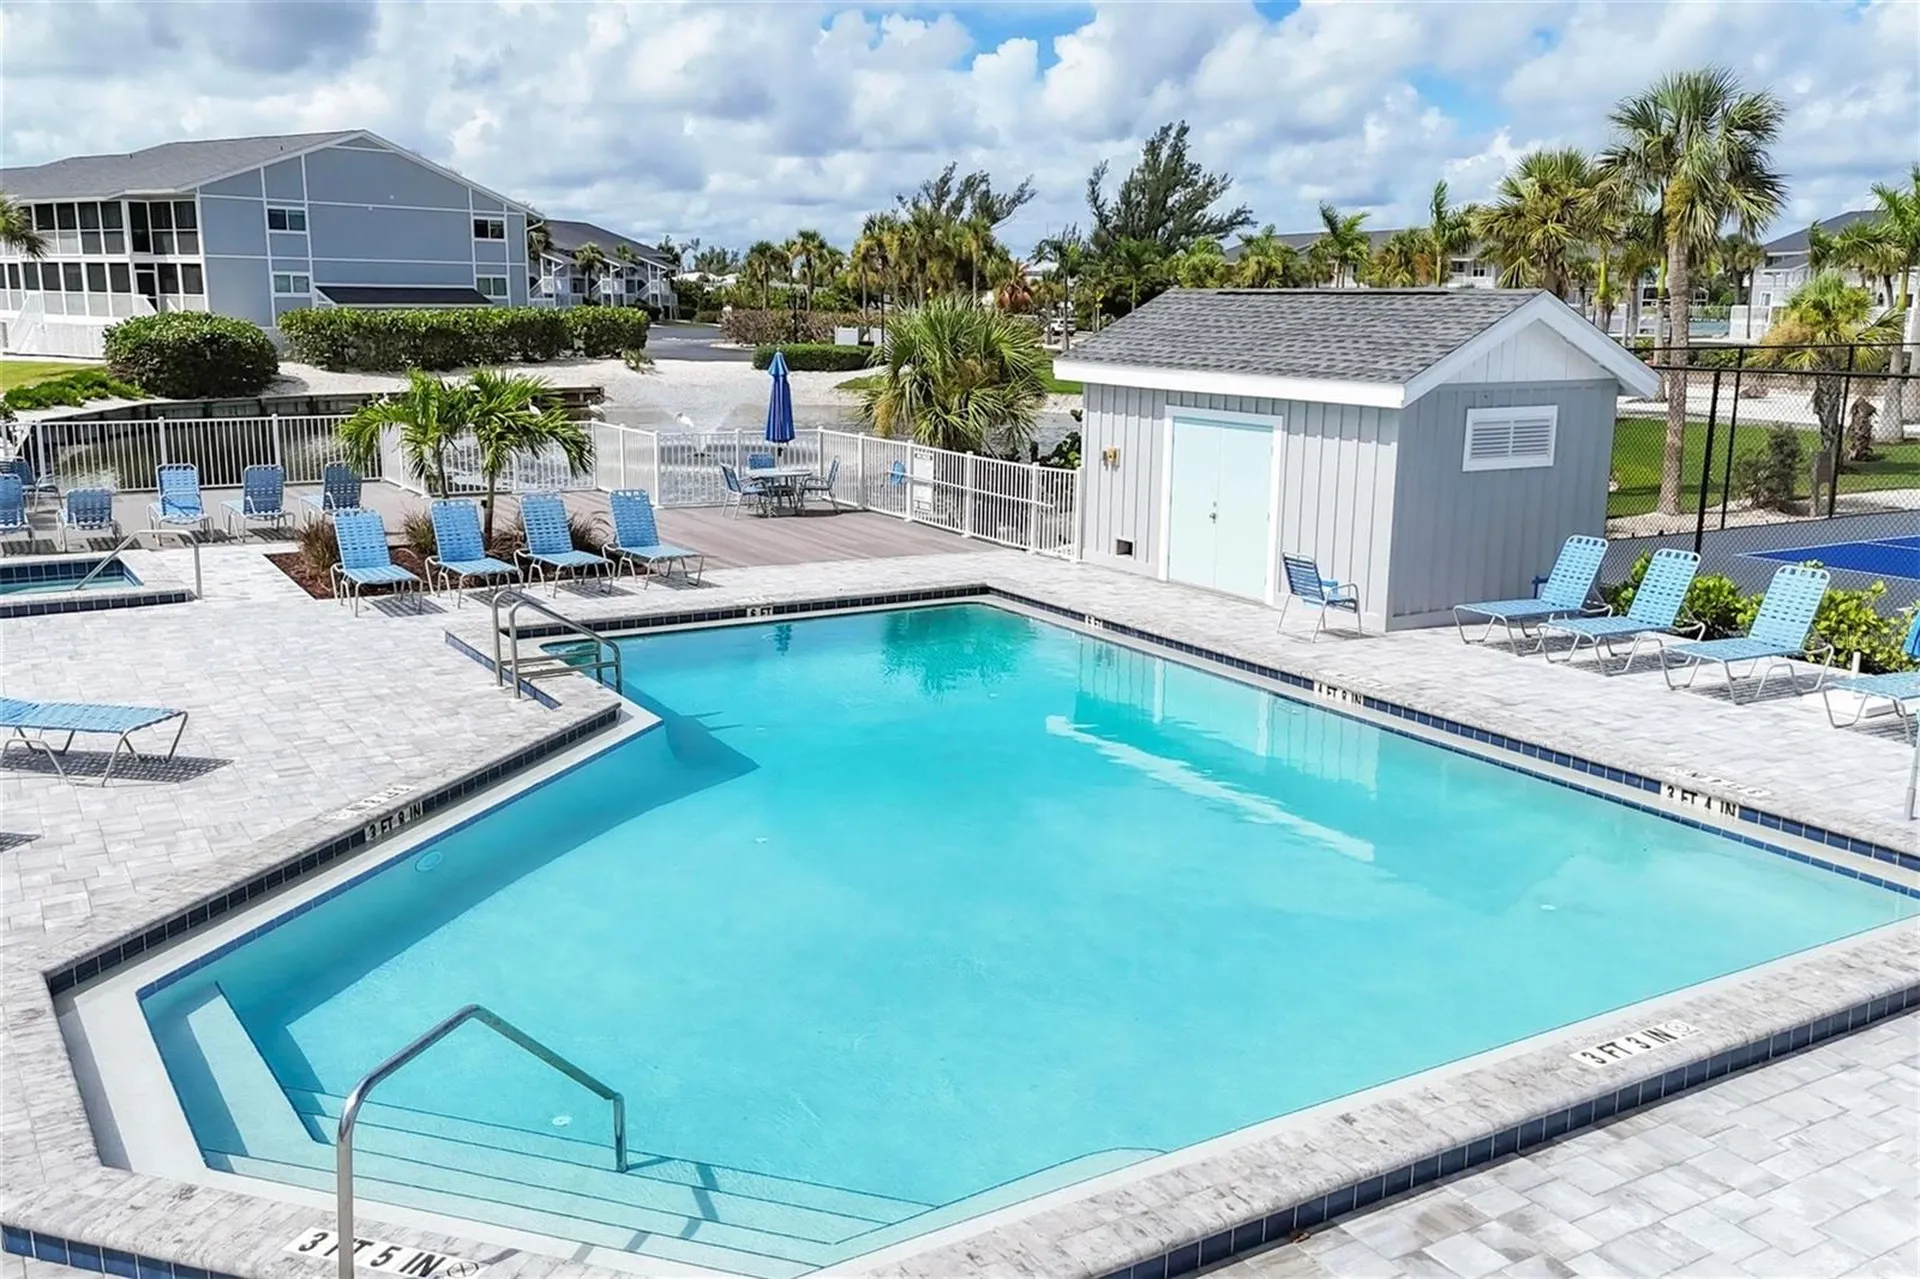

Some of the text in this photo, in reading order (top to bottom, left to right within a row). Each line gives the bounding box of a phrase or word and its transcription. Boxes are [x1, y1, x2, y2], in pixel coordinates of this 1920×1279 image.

[369, 824, 376, 839] 3
[381, 816, 394, 834] FT
[409, 801, 421, 820] IN
[1667, 785, 1737, 817] 3 FT 4 IN
[1580, 1027, 1679, 1065] 3 FT 3 IN
[299, 1231, 329, 1252] 3
[370, 1245, 402, 1267] 5
[399, 1251, 447, 1277] IN
